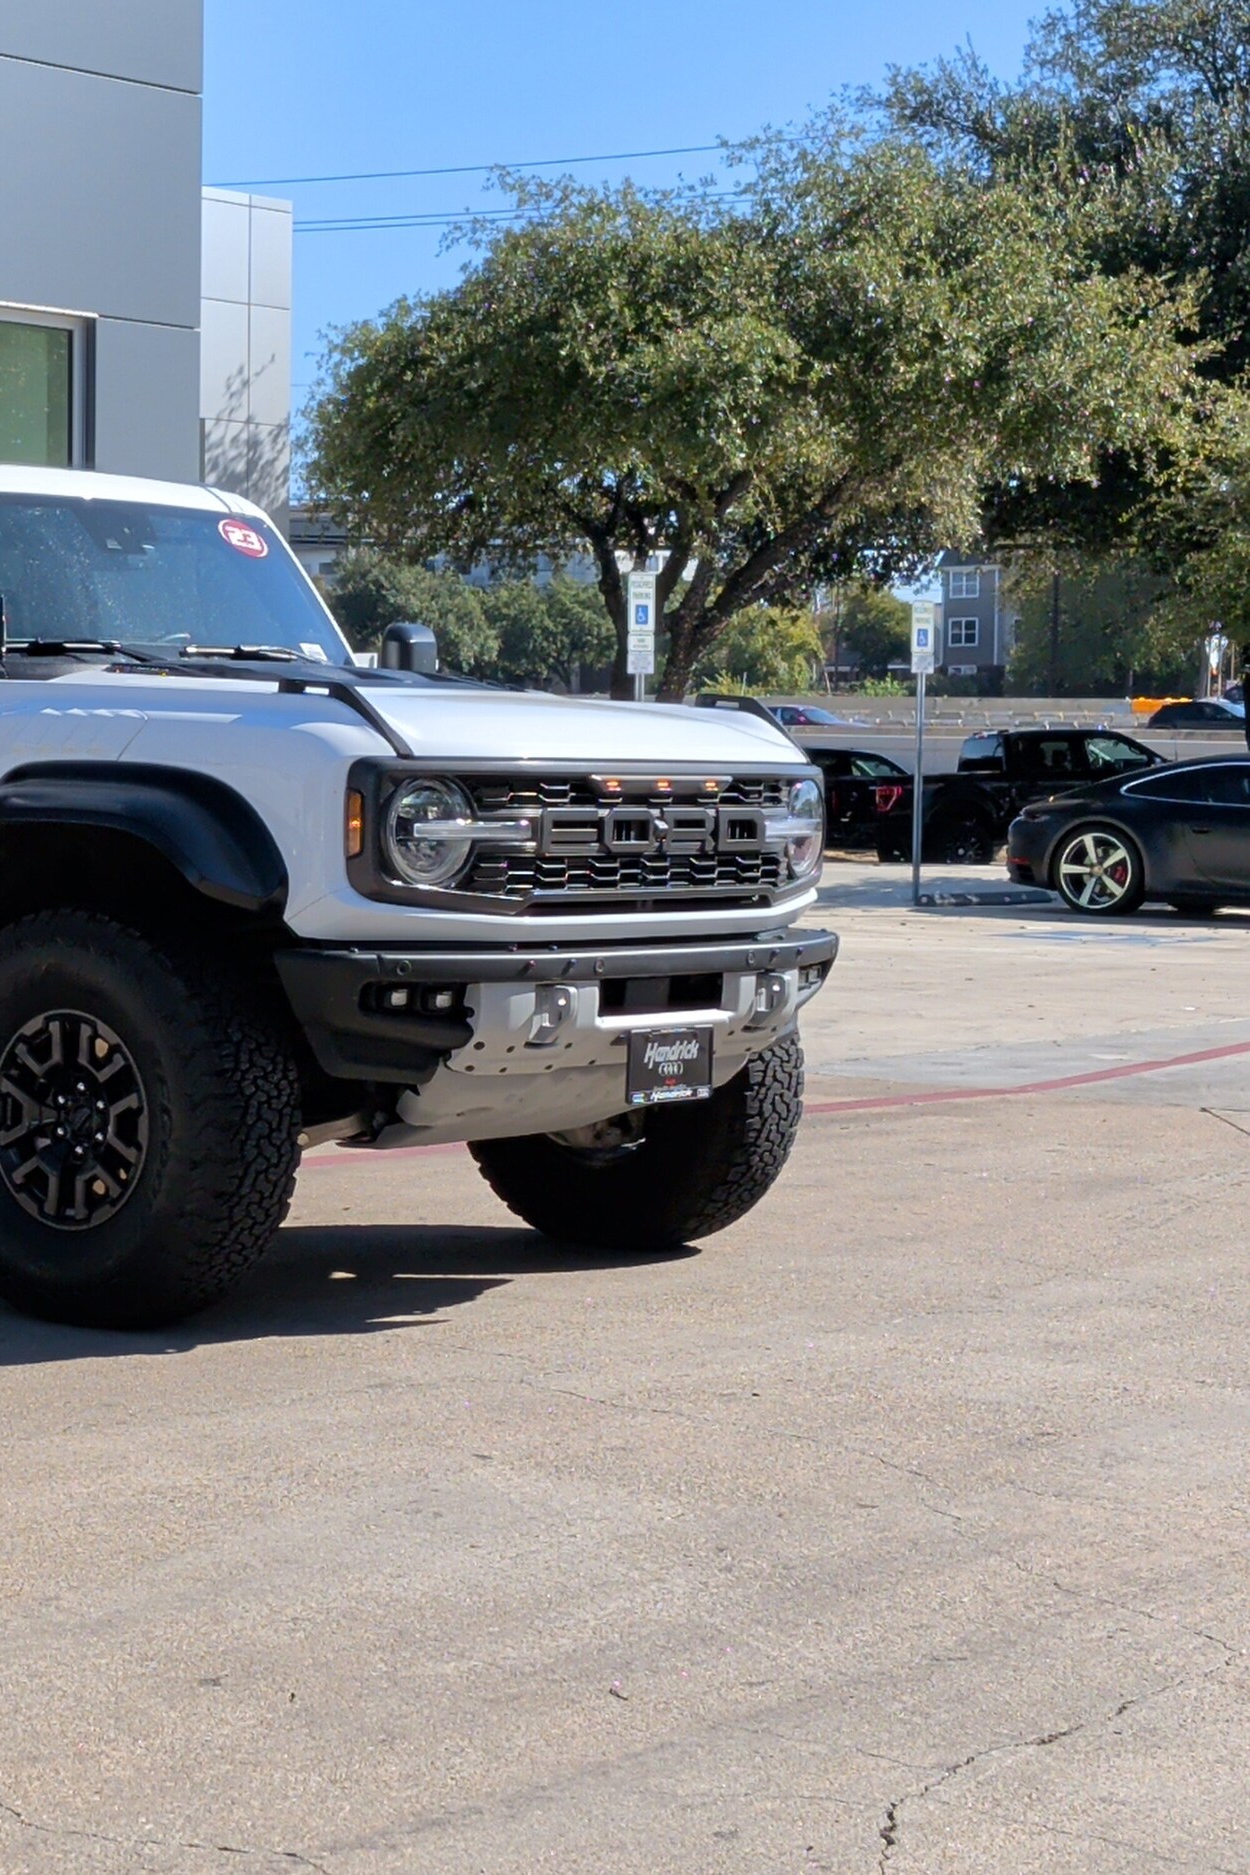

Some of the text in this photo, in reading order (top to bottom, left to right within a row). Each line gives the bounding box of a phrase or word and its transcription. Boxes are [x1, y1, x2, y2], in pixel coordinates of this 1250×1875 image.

[224, 525, 263, 551] 23
[541, 808, 767, 854] FORD
[644, 1040, 699, 1069] Hendrick
